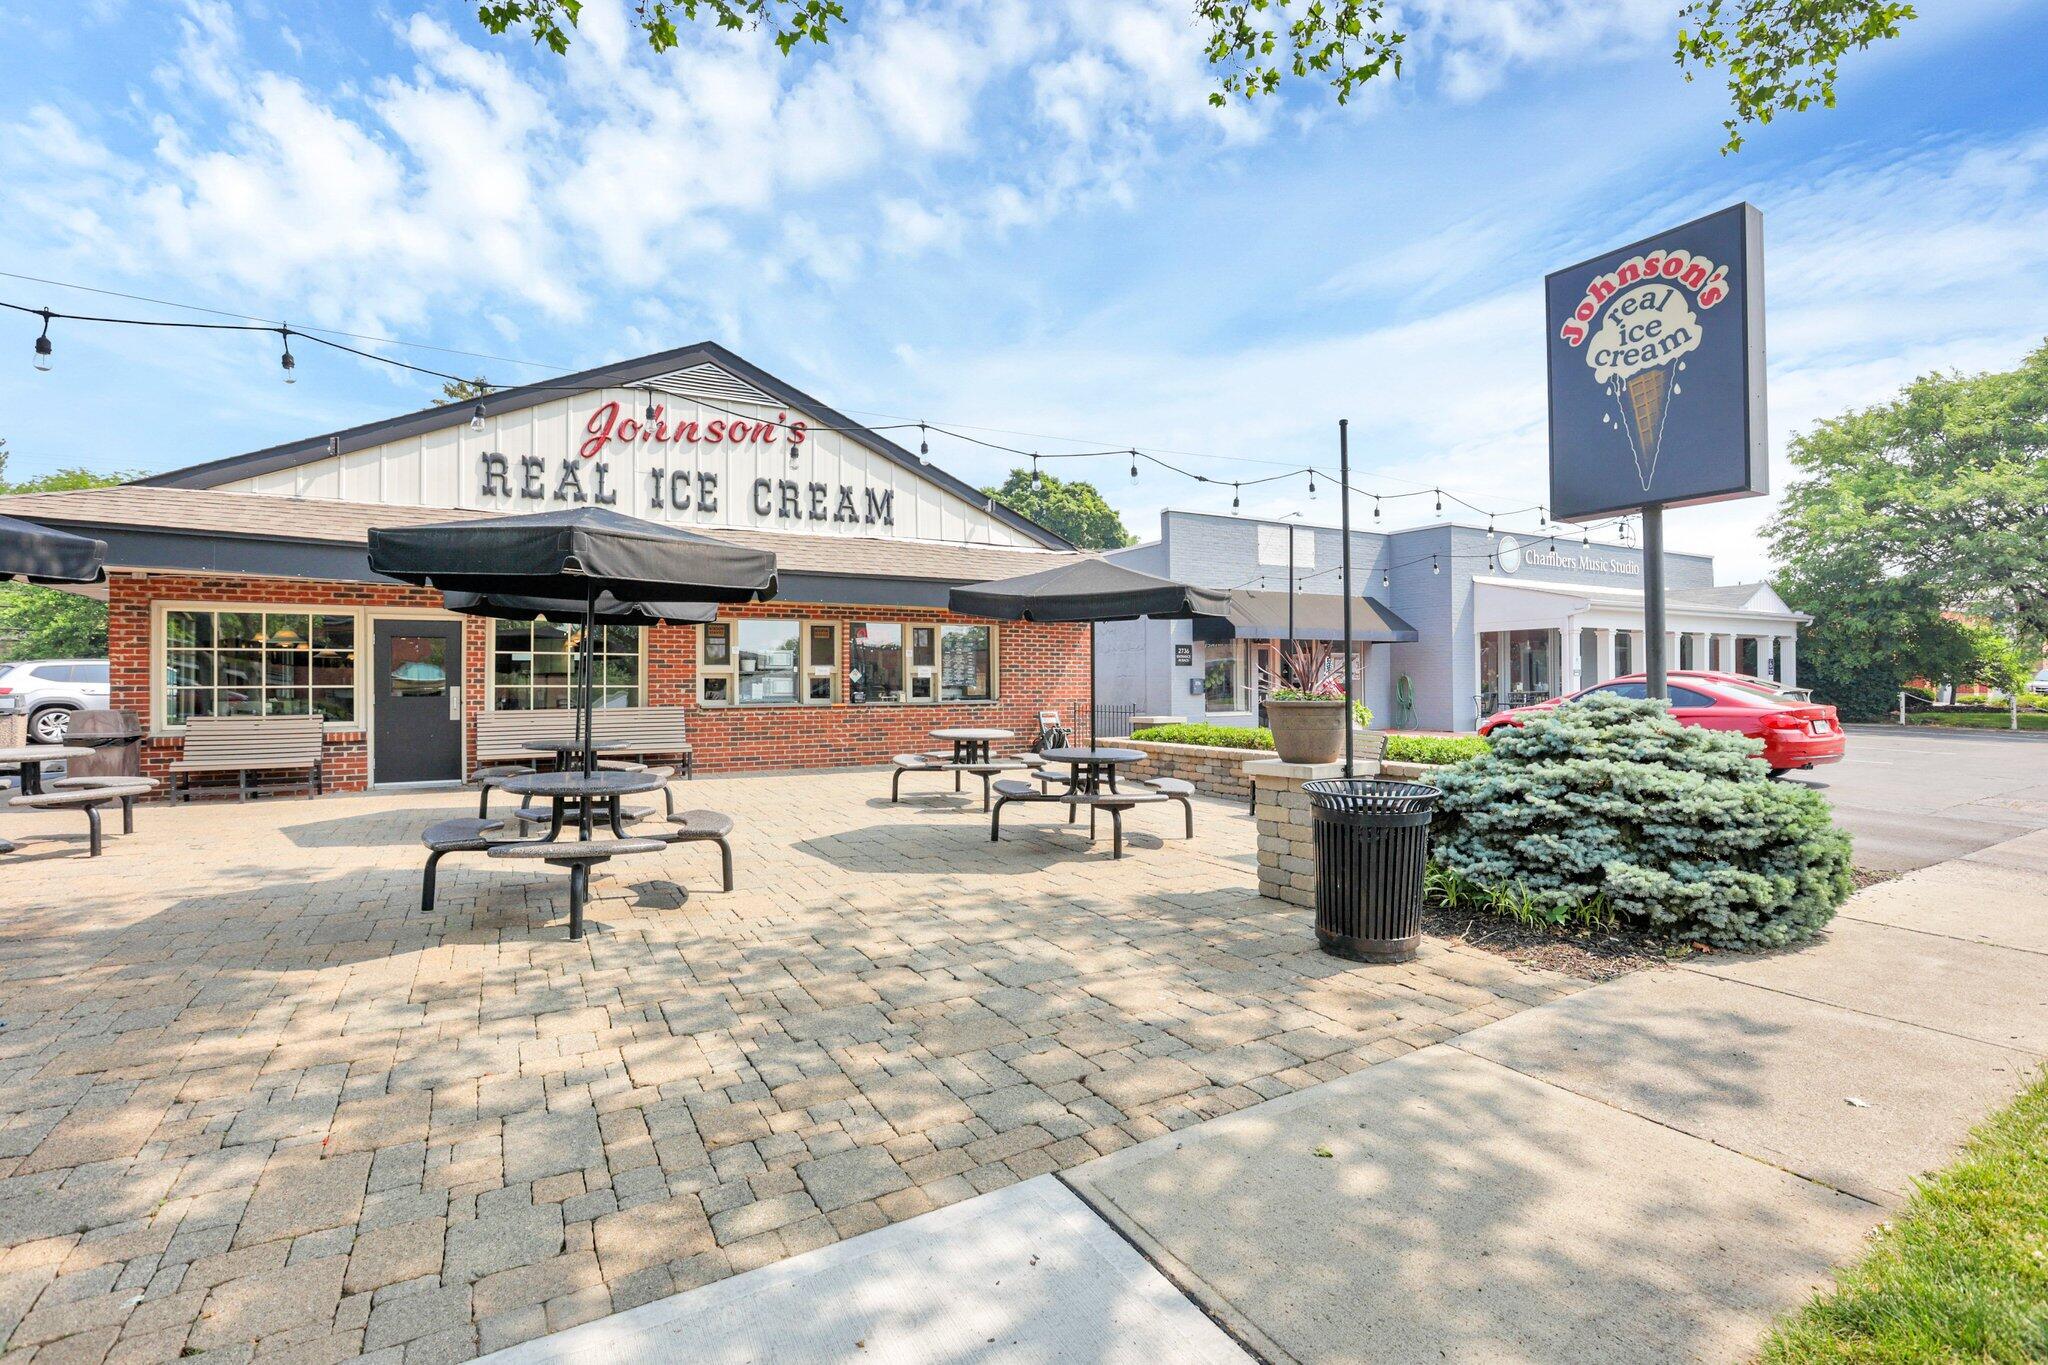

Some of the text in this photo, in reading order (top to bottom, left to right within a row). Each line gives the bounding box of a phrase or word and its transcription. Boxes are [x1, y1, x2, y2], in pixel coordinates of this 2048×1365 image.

[1561, 254, 1724, 346] Johnson's
[1607, 288, 1675, 326] real
[1594, 325, 1693, 368] cream
[1618, 318, 1663, 347] ice
[580, 401, 807, 459] Johnson's
[481, 450, 896, 527] REAL ICE CREAM
[1525, 549, 1640, 575] Chambers Music Studio
